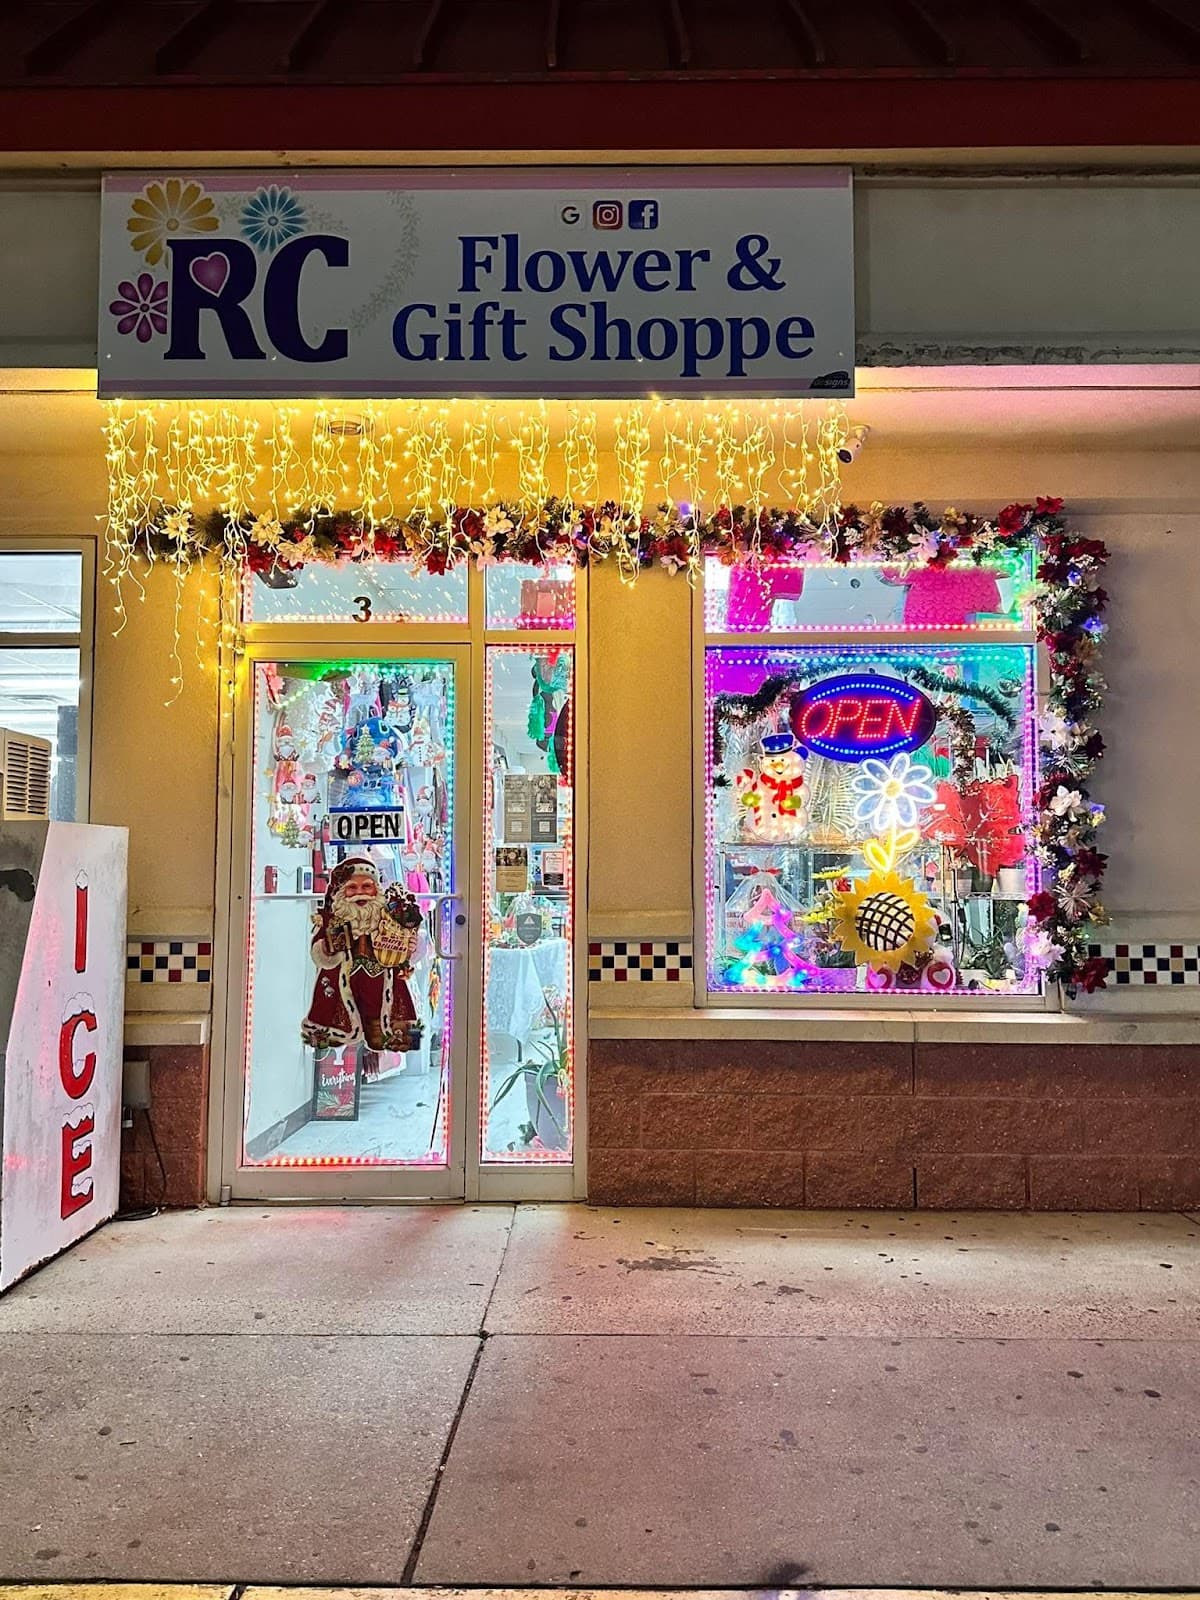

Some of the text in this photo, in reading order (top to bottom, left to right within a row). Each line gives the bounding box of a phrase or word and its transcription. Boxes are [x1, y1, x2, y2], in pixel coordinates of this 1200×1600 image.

[457, 233, 787, 293] Flower &
[163, 234, 349, 363] RC
[392, 301, 816, 378] Gift Shoppe
[352, 596, 372, 623] 3
[801, 698, 921, 739] OPEN
[337, 813, 400, 840] OPEN
[58, 869, 98, 1222] ICE
[321, 1067, 356, 1090] Everything
